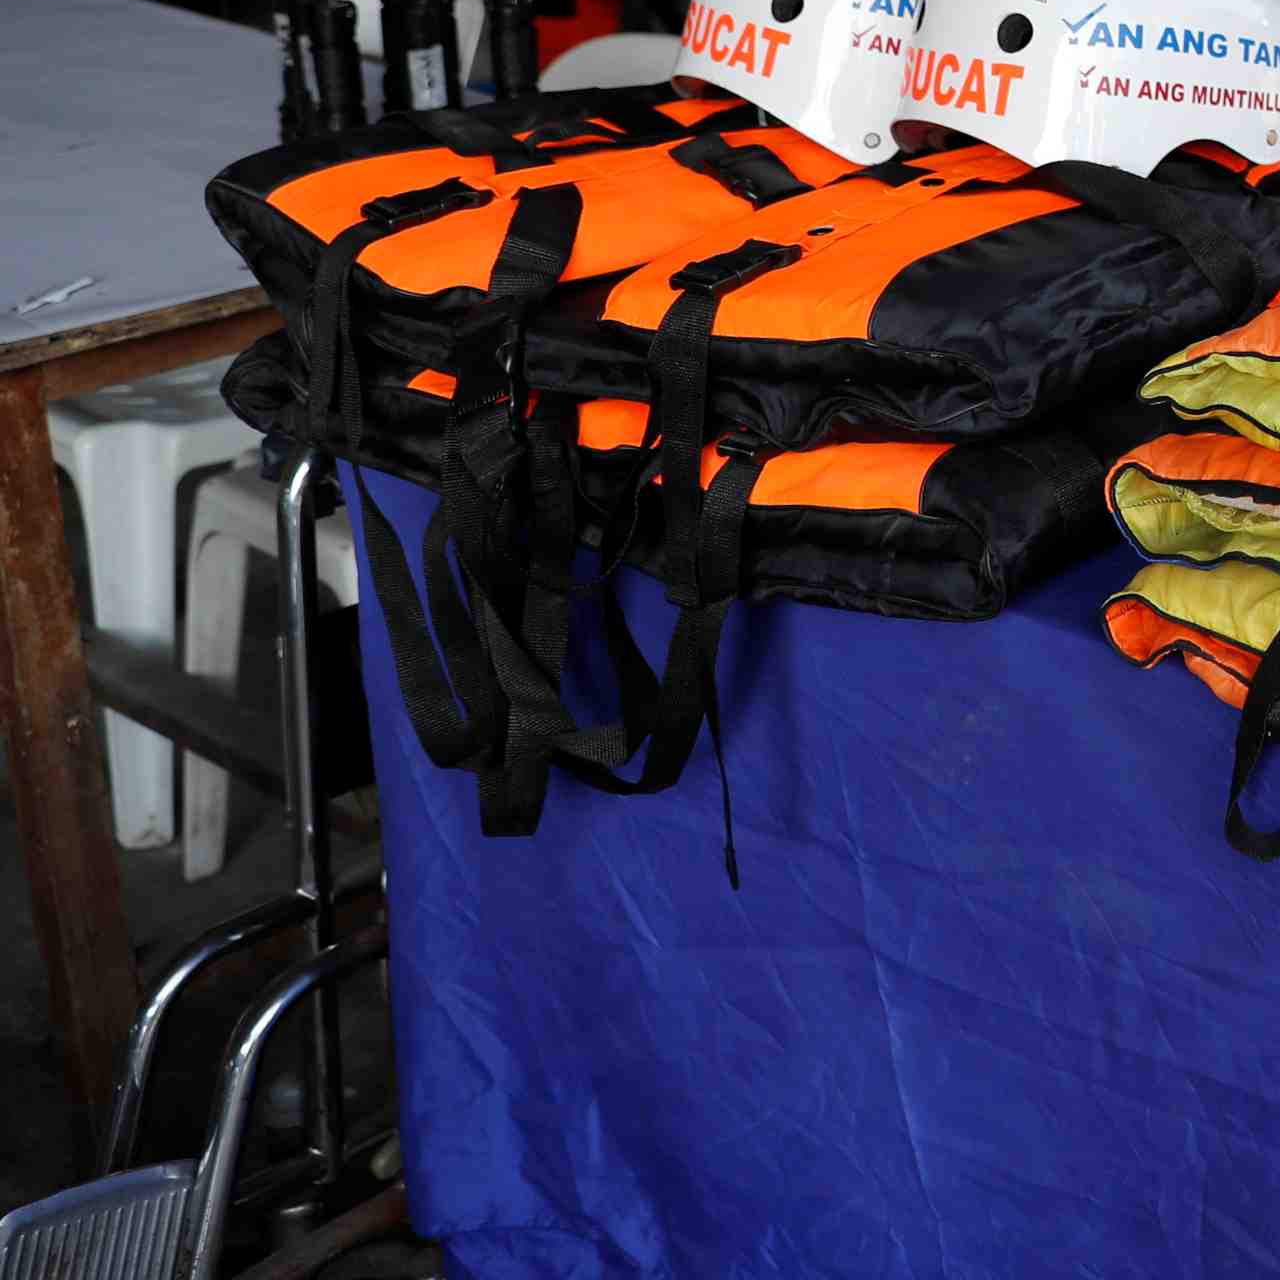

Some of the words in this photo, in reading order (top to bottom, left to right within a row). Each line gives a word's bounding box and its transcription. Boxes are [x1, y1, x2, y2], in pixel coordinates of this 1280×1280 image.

[682, 0, 792, 78] SUCAT
[1156, 27, 1228, 58] ANG
[901, 47, 1025, 117] SUCAT
[1138, 80, 1185, 103] ANG
